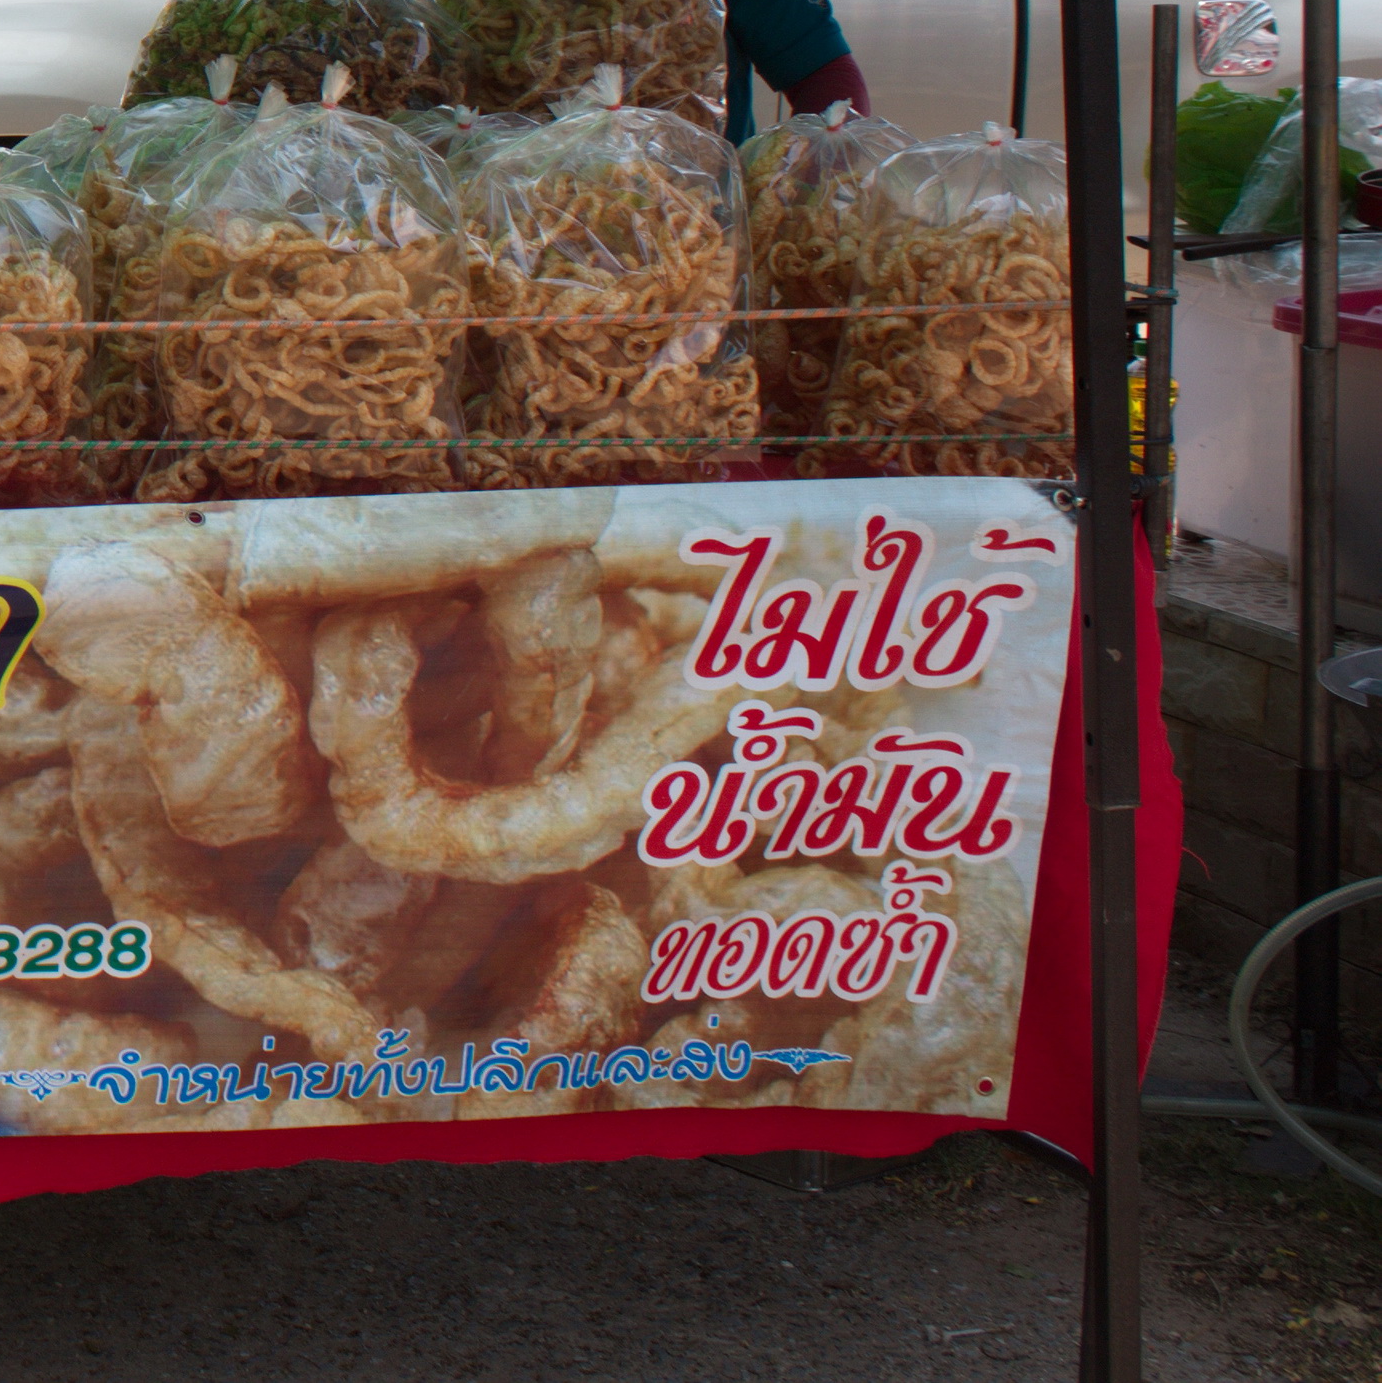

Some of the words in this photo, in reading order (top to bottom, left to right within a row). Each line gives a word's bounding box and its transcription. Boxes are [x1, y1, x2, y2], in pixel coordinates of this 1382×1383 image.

[690, 515, 1056, 681] ไม่ใช้
[645, 708, 1013, 860] น้ำมัน
[647, 865, 949, 996] ทอดซ้ำ
[87, 1014, 754, 1105] จำหน่ายทั้งปลีกและส่ง
